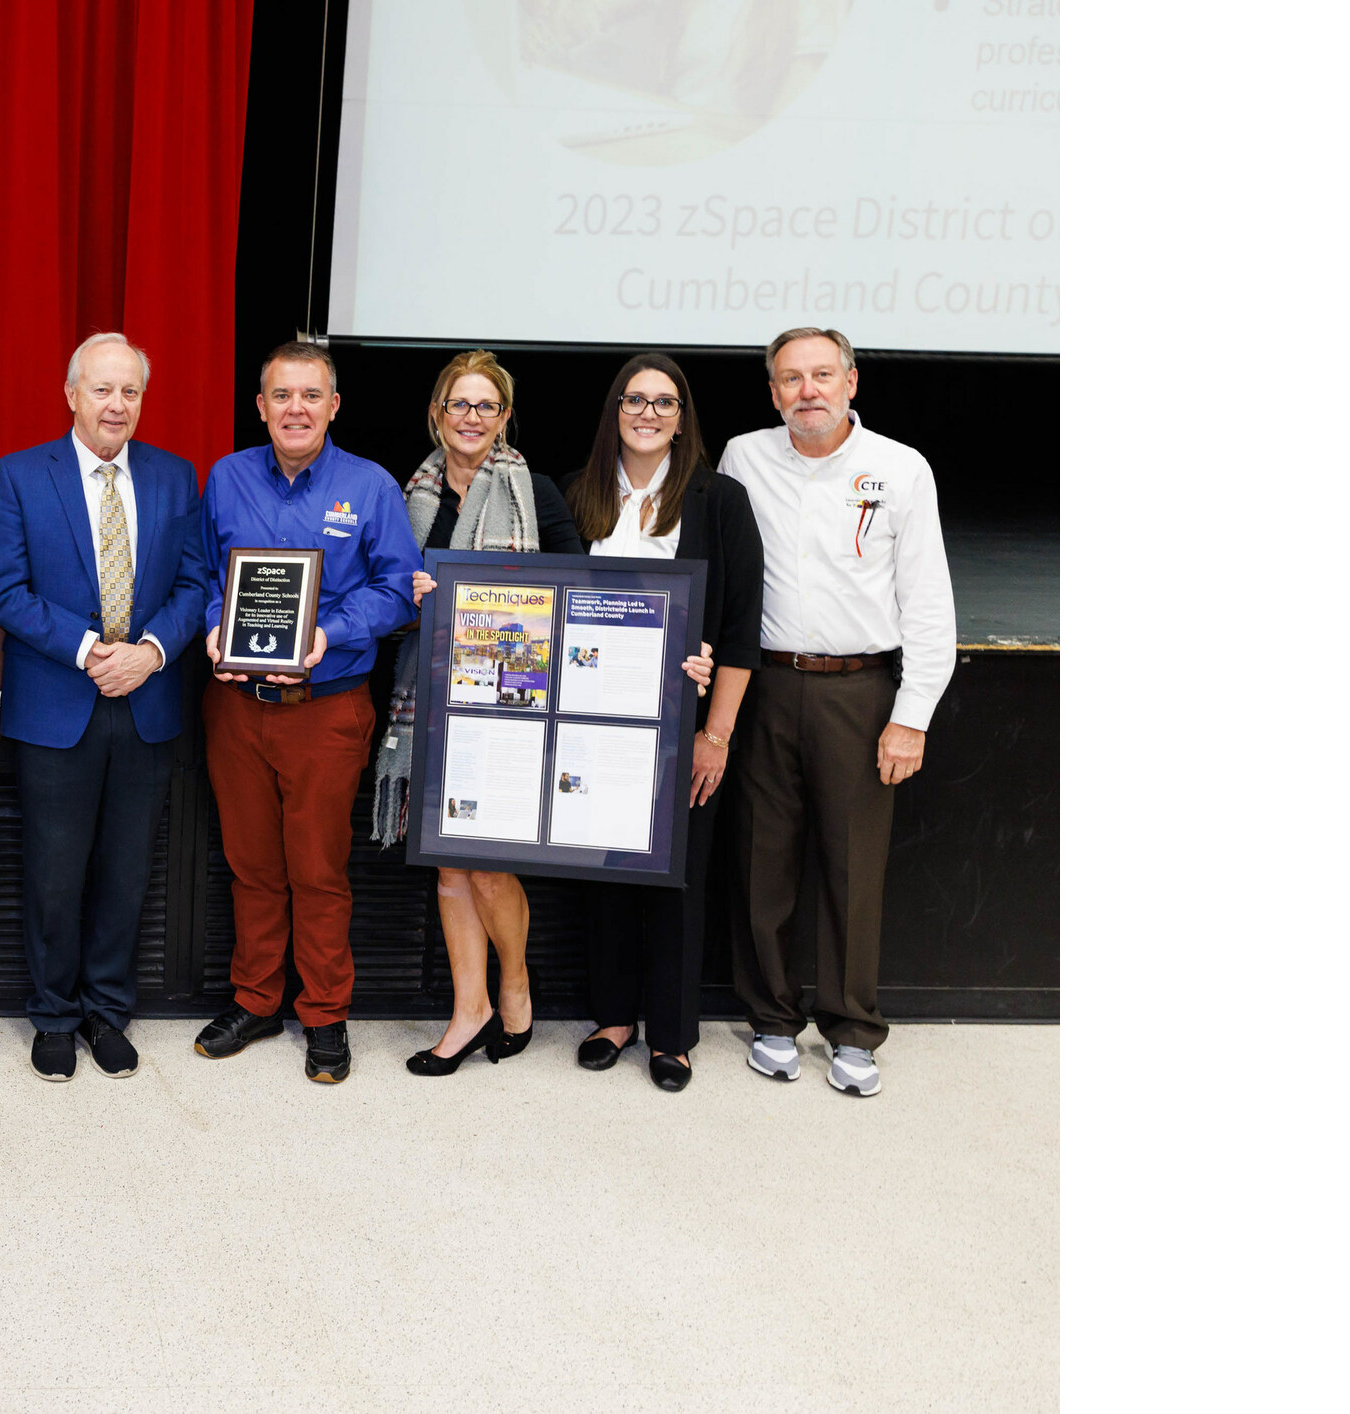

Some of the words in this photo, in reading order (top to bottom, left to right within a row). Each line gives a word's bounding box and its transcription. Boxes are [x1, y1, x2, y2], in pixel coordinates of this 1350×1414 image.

[983, 0, 1060, 17] Strat
[975, 35, 1060, 73] profe
[970, 82, 1060, 113] curric
[554, 193, 662, 237] 2023
[676, 194, 838, 250] zSpace
[852, 194, 1015, 241] District
[617, 266, 899, 314] Cumberland
[861, 481, 885, 491] CTE
[257, 567, 286, 576] zSpace
[464, 587, 545, 607] Techniques
[572, 598, 602, 606] Teamwork,
[603, 599, 627, 607] Planning
[460, 612, 492, 627] VISION
[604, 612, 624, 620] County
[466, 629, 474, 640] IN
[476, 629, 489, 641] THE
[490, 630, 529, 643] SPOTLIGHT
[464, 668, 495, 676] VISION
